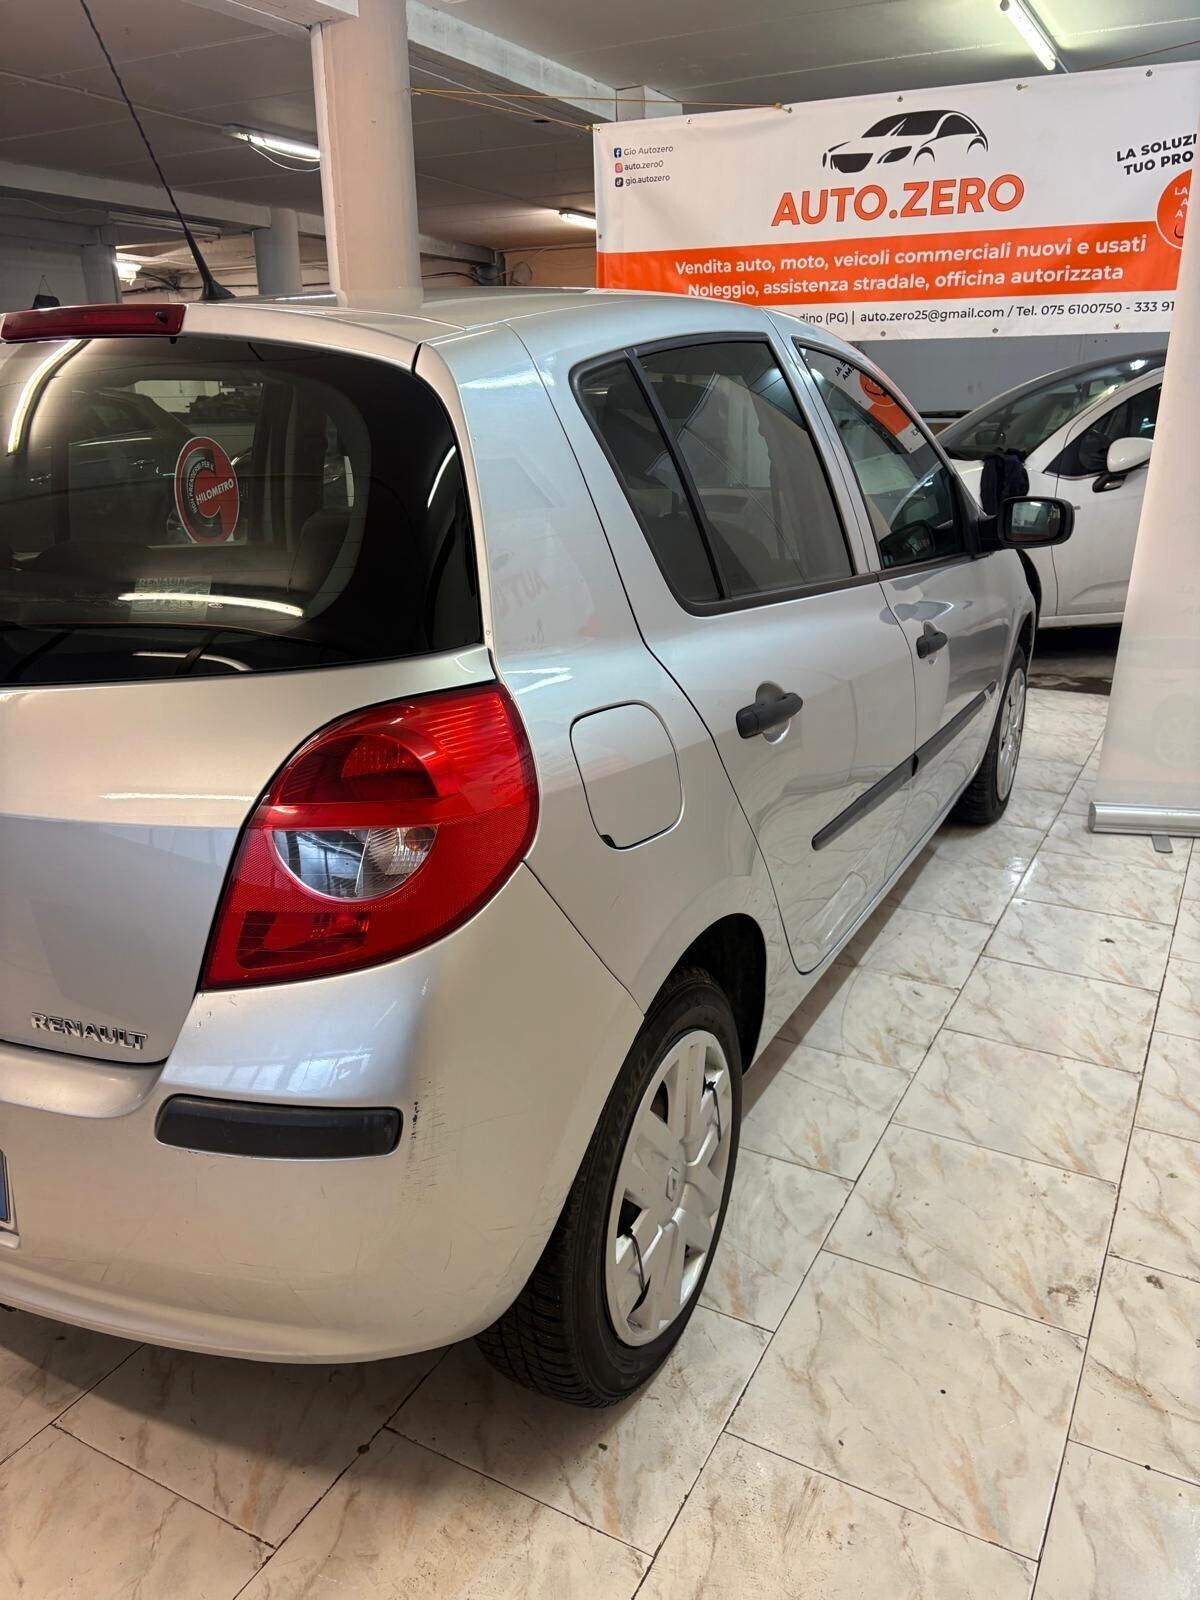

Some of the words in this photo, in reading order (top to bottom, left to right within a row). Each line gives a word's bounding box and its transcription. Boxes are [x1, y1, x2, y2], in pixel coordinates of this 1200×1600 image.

[623, 147, 637, 156] Gio
[638, 145, 674, 156] Autozero
[1116, 148, 1137, 162] LA
[1141, 133, 1197, 157] SOLUZI
[1123, 160, 1156, 175] TUO
[1160, 150, 1194, 168] PRO
[625, 173, 671, 186] gio.autozero
[771, 173, 1025, 227] AUTO.ZERO
[675, 261, 732, 276] Vendita
[735, 259, 776, 274] auto,
[780, 255, 829, 272] moto,
[834, 248, 890, 267] veicoli
[894, 242, 1011, 264] commerciali
[1016, 238, 1071, 258] nuovi
[1077, 241, 1089, 255] e
[1095, 234, 1147, 254] usati
[687, 281, 759, 299] Noleggio,
[763, 277, 848, 294] assistenza
[853, 271, 930, 290] stradale,
[935, 267, 1005, 288] officina
[1010, 264, 1124, 284] autorizzata
[825, 311, 848, 325] (PG)
[859, 305, 1005, 323] auto.zero25@gmail.com
[1016, 305, 1038, 317] Tel.
[1041, 304, 1065, 316] 075
[1068, 302, 1122, 315] 6100750
[1134, 301, 1158, 313] 333
[1161, 300, 1176, 312] 91
[30, 1011, 149, 1050] RENAULT
